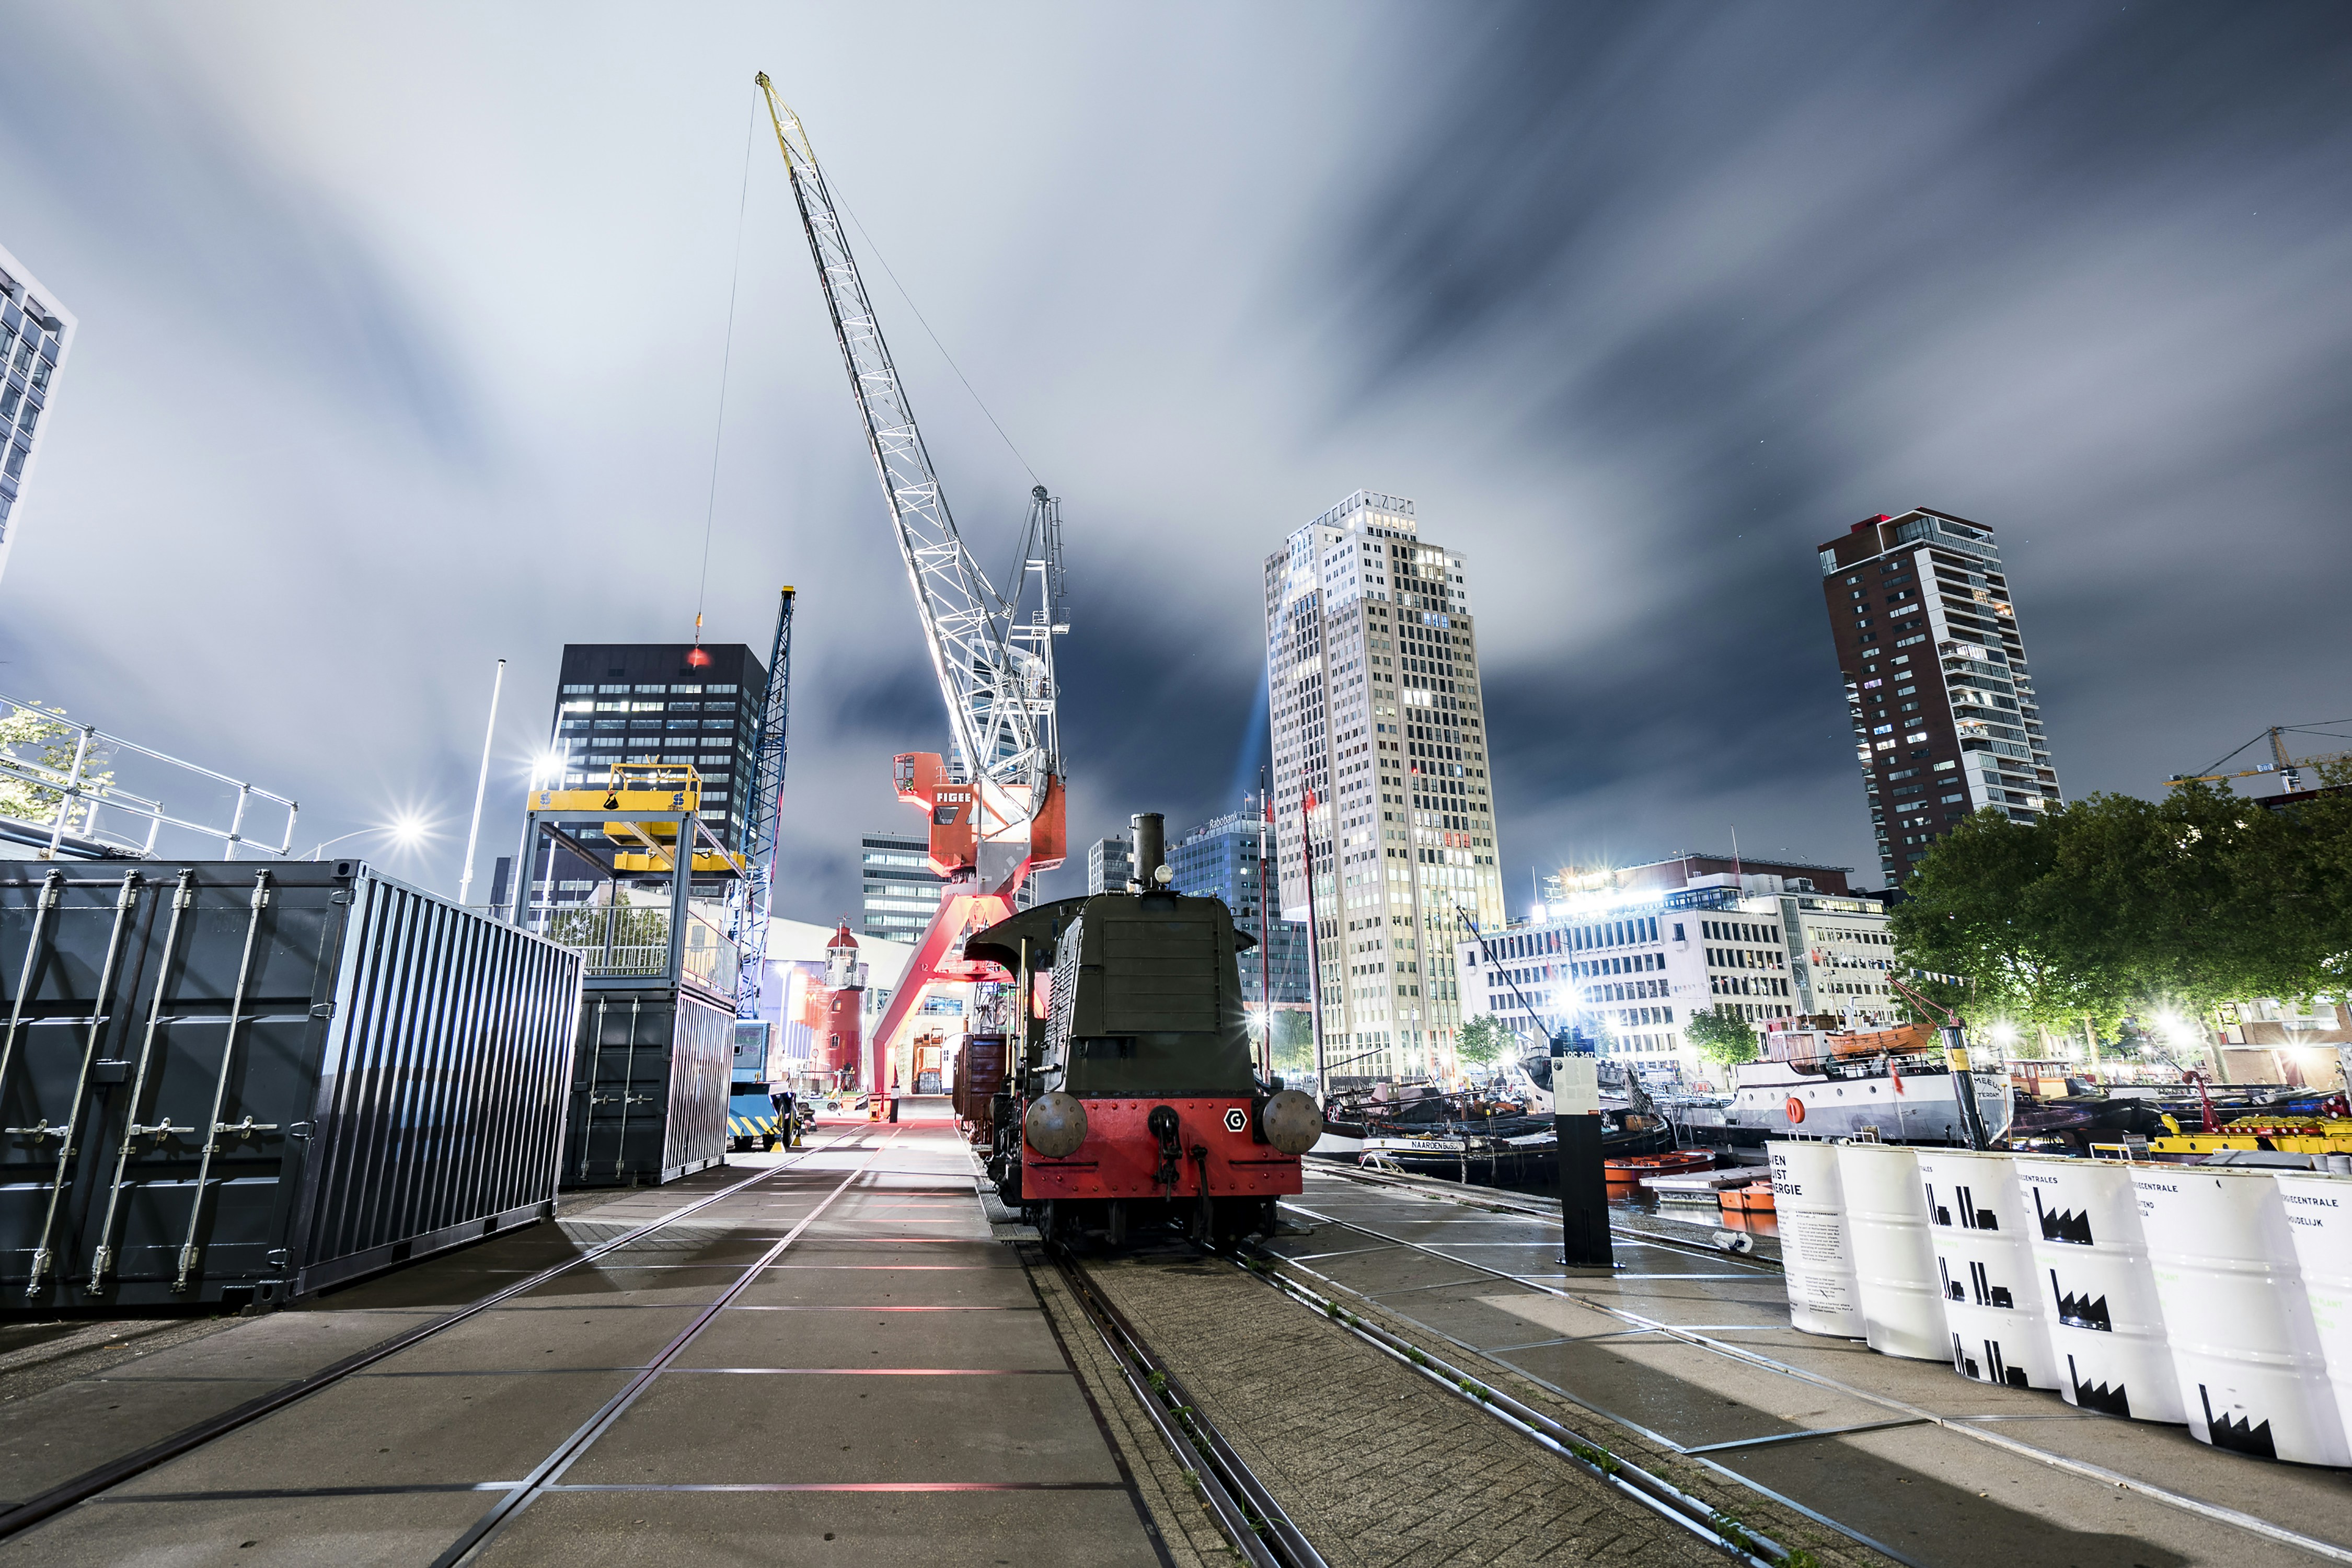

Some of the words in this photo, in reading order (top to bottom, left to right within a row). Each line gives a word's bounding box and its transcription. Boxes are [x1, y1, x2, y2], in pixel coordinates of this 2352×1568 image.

[937, 793, 971, 802] FIGEE
[1209, 810, 1238, 829] Rabobank
[1230, 1113, 1241, 1127] G
